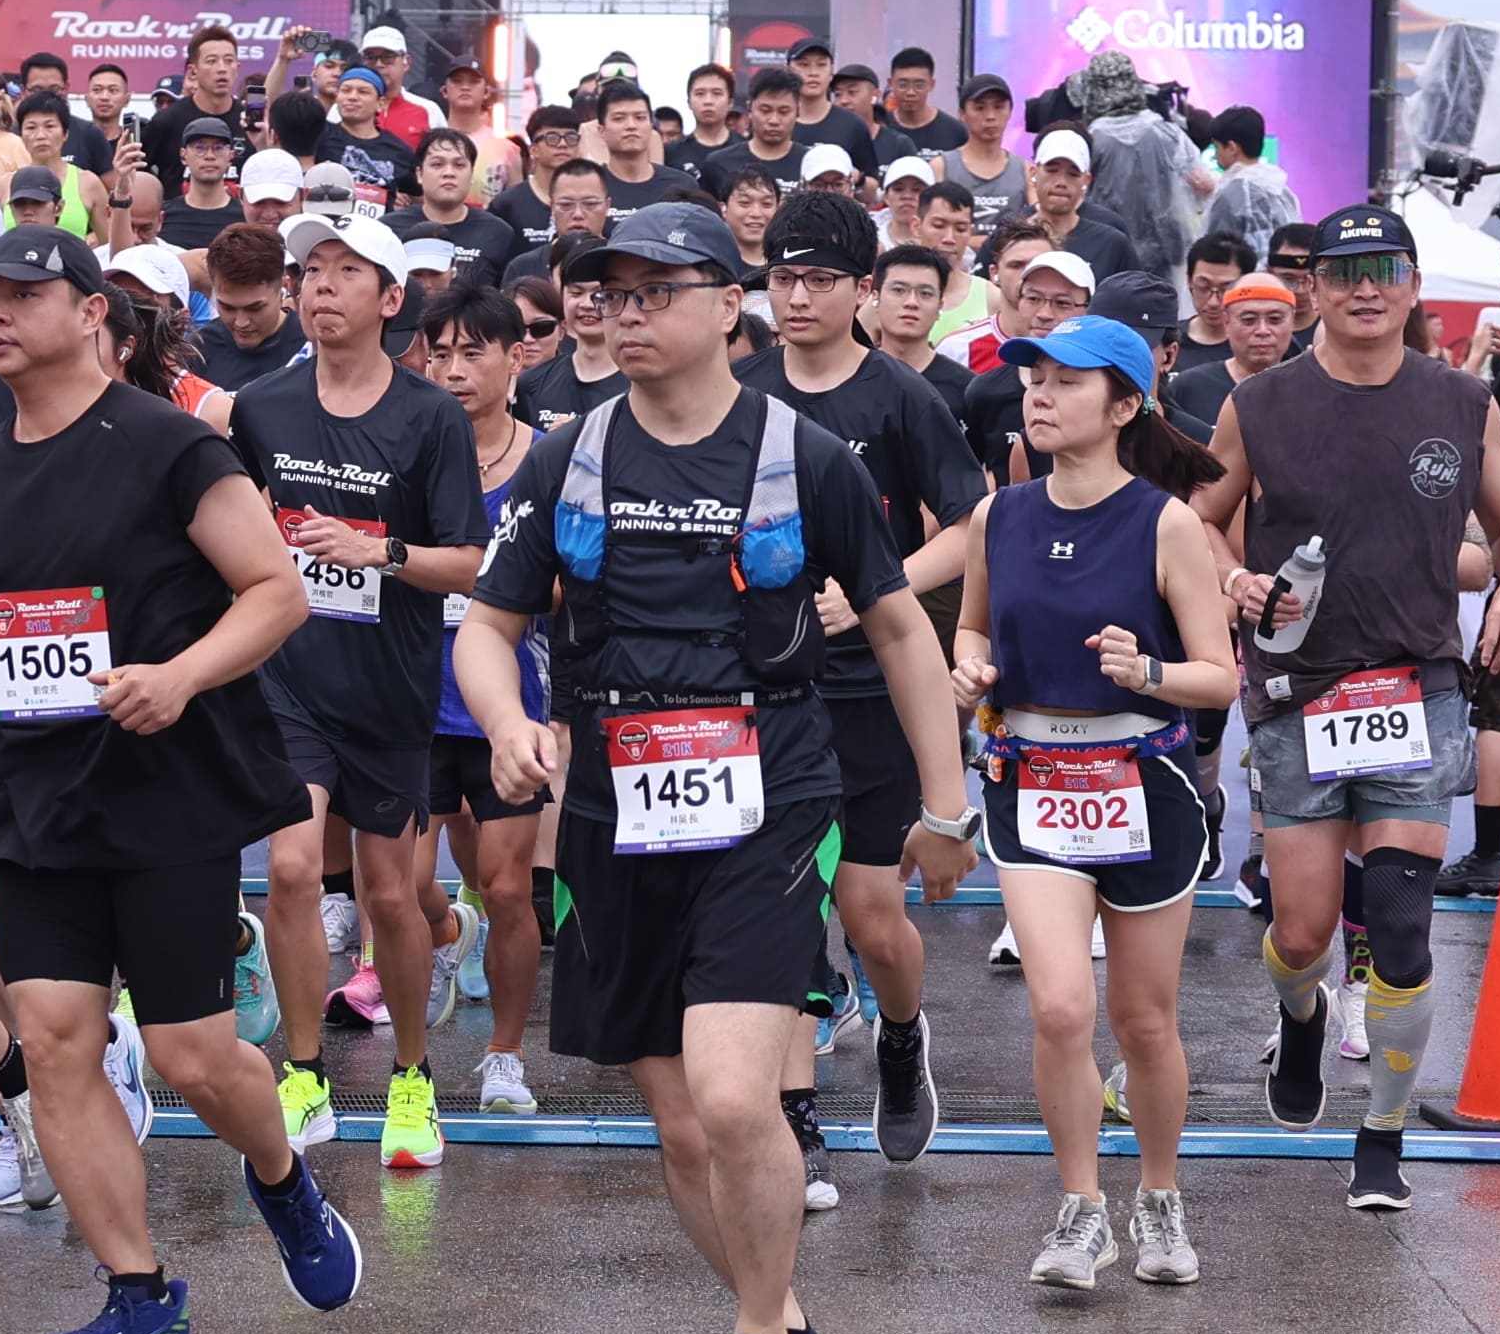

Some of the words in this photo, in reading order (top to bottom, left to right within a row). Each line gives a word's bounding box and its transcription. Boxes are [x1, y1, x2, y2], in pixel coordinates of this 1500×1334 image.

[51, 11, 163, 39] Rock
[1112, 9, 1305, 50] Columbia
[71, 45, 179, 59] RUNNING
[182, 46, 265, 60] SES
[357, 201, 382, 218] 60
[973, 196, 1009, 206] ROOKS
[1338, 228, 1382, 240] AKIWEI
[273, 453, 327, 473] Rock
[342, 464, 391, 487] Roll
[1415, 456, 1460, 482] RUN!
[280, 472, 332, 488] RUNNING
[334, 478, 377, 496] SERIES
[610, 499, 667, 517] ock
[692, 499, 743, 521] Ro
[292, 553, 367, 591] 456
[16, 602, 46, 613] Rock
[55, 599, 83, 610] Roll
[26, 620, 53, 634] 21K
[1340, 680, 1368, 691] Rock
[1377, 677, 1400, 687] Roll
[663, 694, 679, 704] To
[693, 692, 741, 706] Somebody
[651, 723, 687, 736] Rock
[696, 719, 729, 732] Roll
[1050, 723, 1089, 736] ROXY
[1321, 710, 1410, 748] 1789
[662, 742, 694, 757] 21K
[1056, 760, 1084, 772] Rock
[1092, 758, 1117, 769] Roll
[633, 766, 735, 811] 1451
[1036, 796, 1130, 831] 2302
